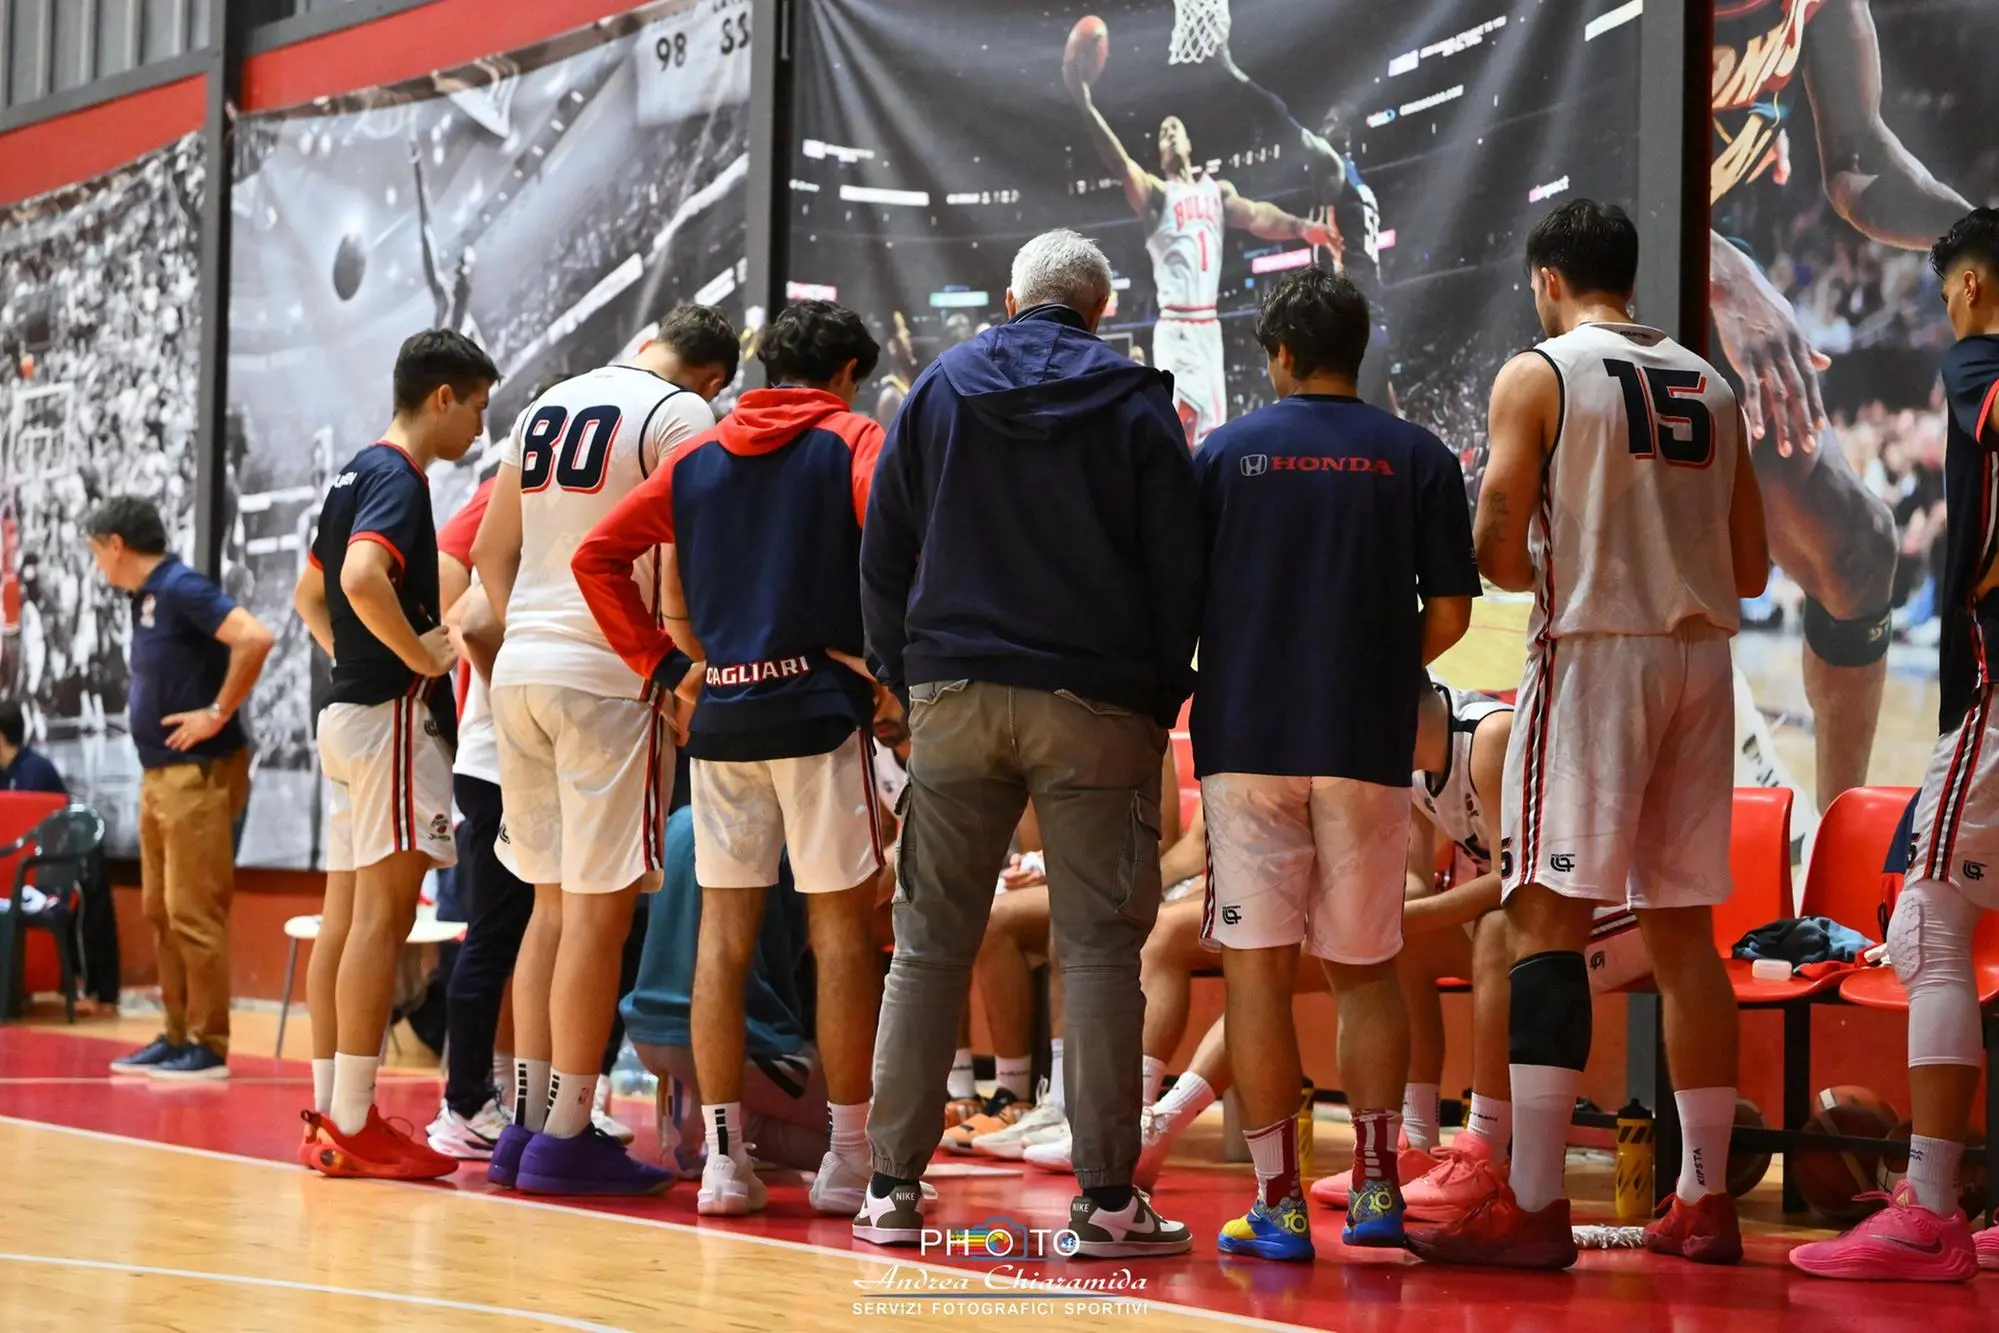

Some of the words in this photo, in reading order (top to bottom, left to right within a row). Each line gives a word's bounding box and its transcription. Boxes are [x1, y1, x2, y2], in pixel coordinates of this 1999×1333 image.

[655, 31, 687, 72] 98
[1197, 230, 1209, 272] 1
[1602, 358, 1716, 470] 15
[521, 404, 623, 495] 80
[1271, 456, 1396, 476] HONDA
[706, 656, 810, 685] CAGLIARI
[1693, 1147, 1706, 1187] KIPSTA
[895, 1192, 916, 1201] NIKE
[1072, 1202, 1090, 1213] NIKE
